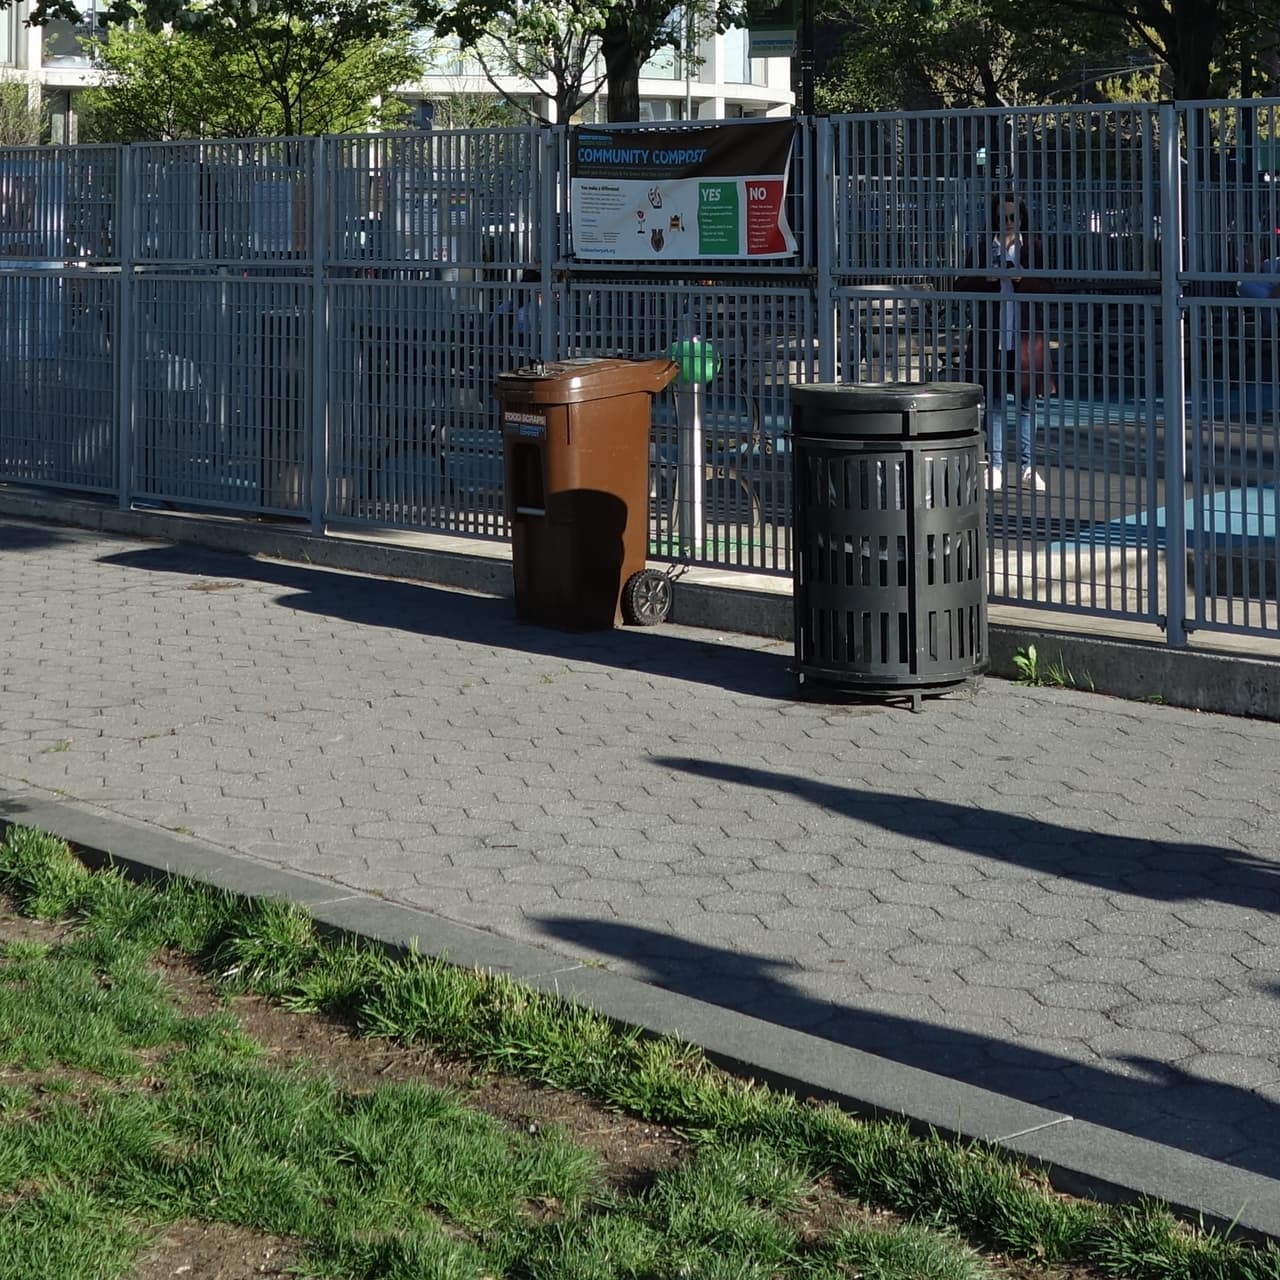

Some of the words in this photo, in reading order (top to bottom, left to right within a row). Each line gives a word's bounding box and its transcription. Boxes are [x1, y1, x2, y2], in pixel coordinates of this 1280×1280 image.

[578, 148, 649, 164] COMMUNITY
[652, 148, 707, 164] COMPOST
[701, 188, 721, 201] YES
[749, 187, 767, 200] NO
[504, 411, 521, 422] FOOD
